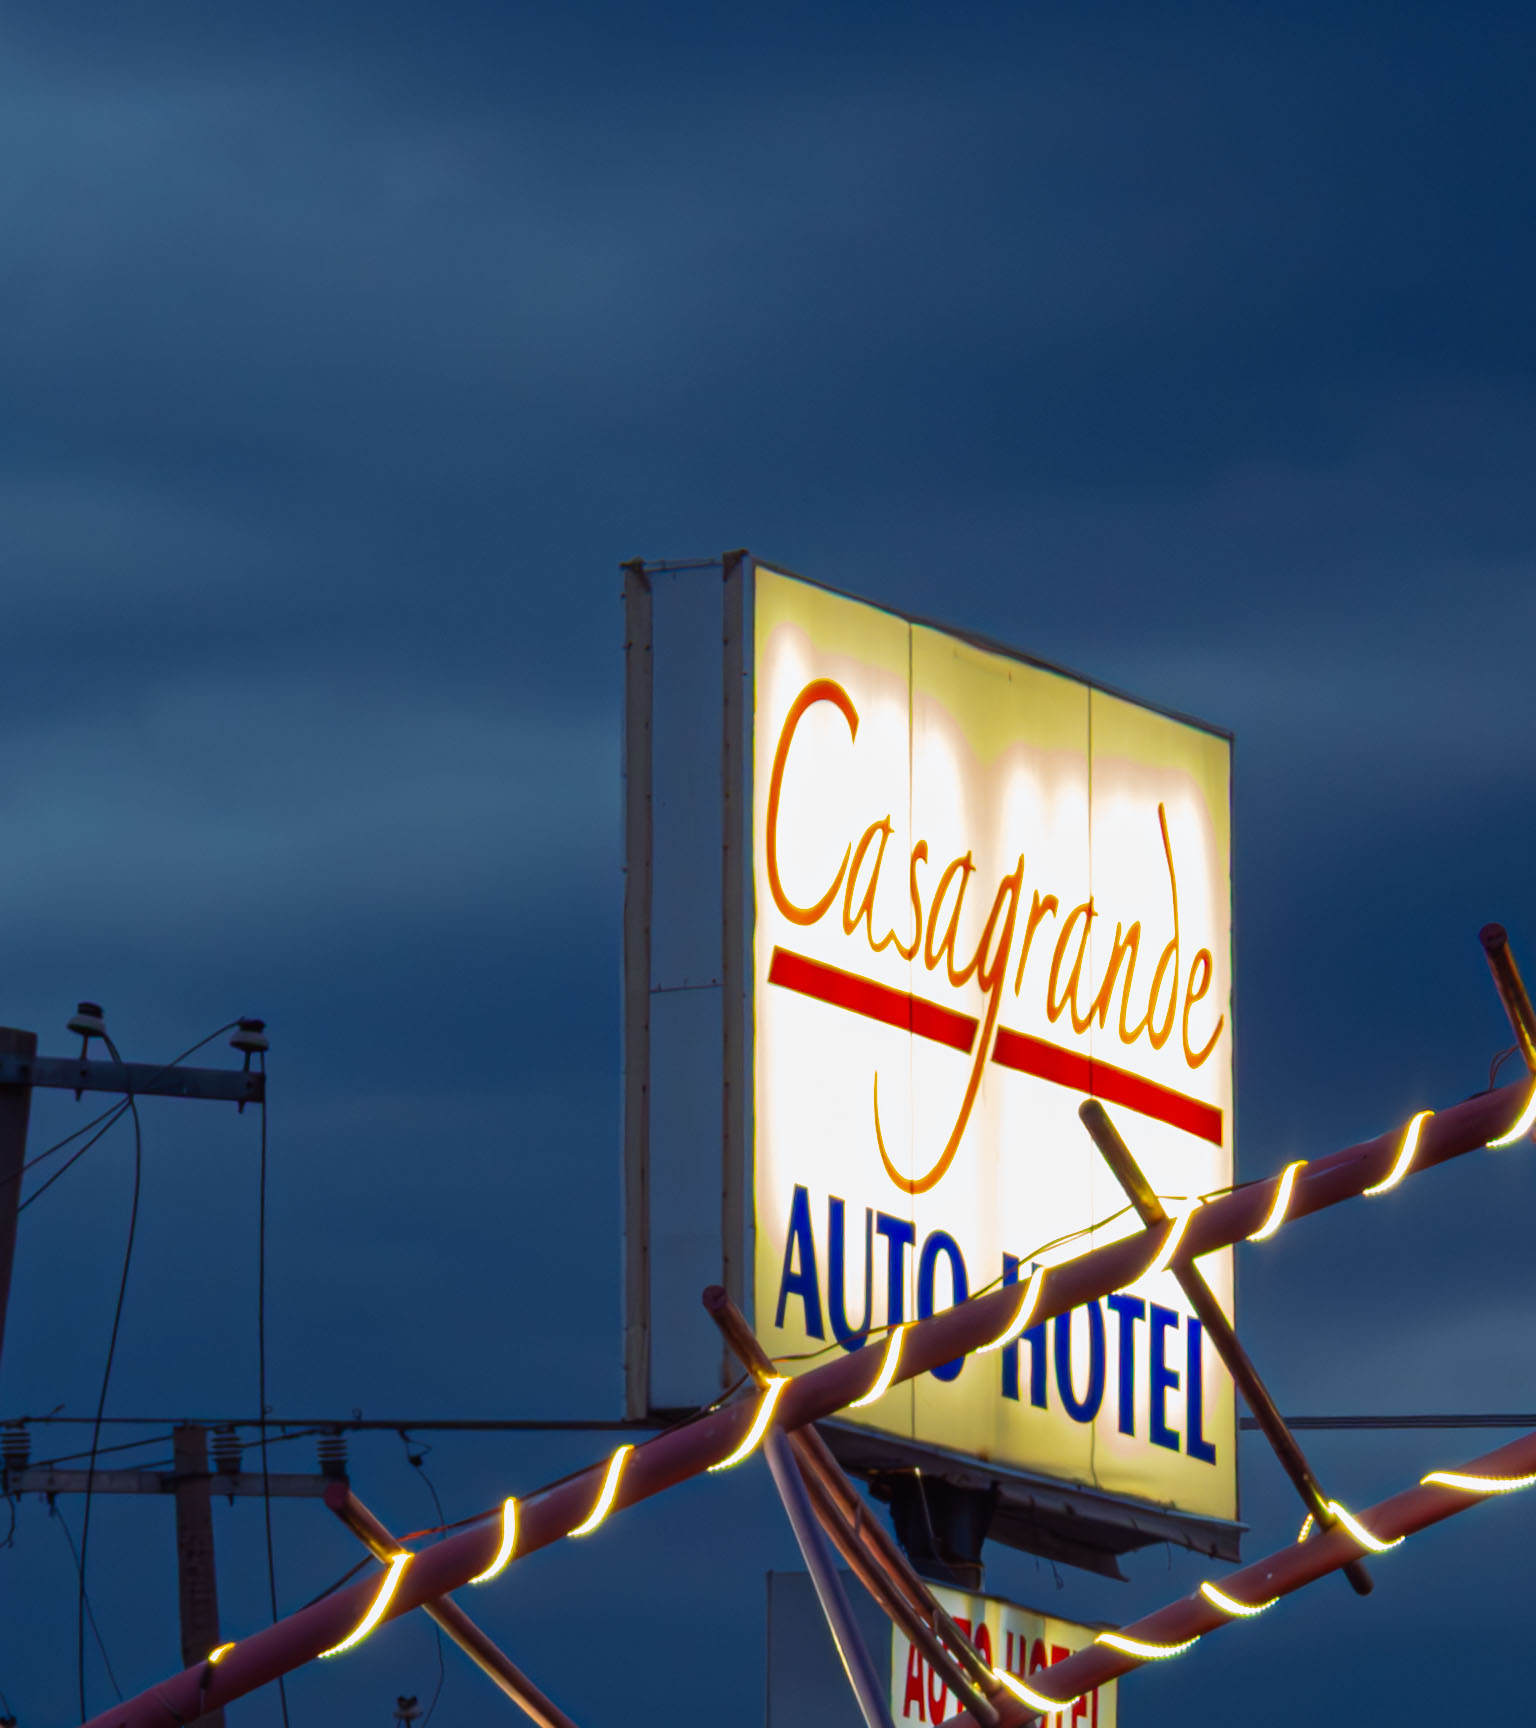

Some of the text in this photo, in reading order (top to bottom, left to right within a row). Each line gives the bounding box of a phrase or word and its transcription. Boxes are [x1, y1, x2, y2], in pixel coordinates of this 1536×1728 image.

[767, 678, 1224, 1194] Casagrande
[775, 1183, 1216, 1466] AUTO HOTEL
